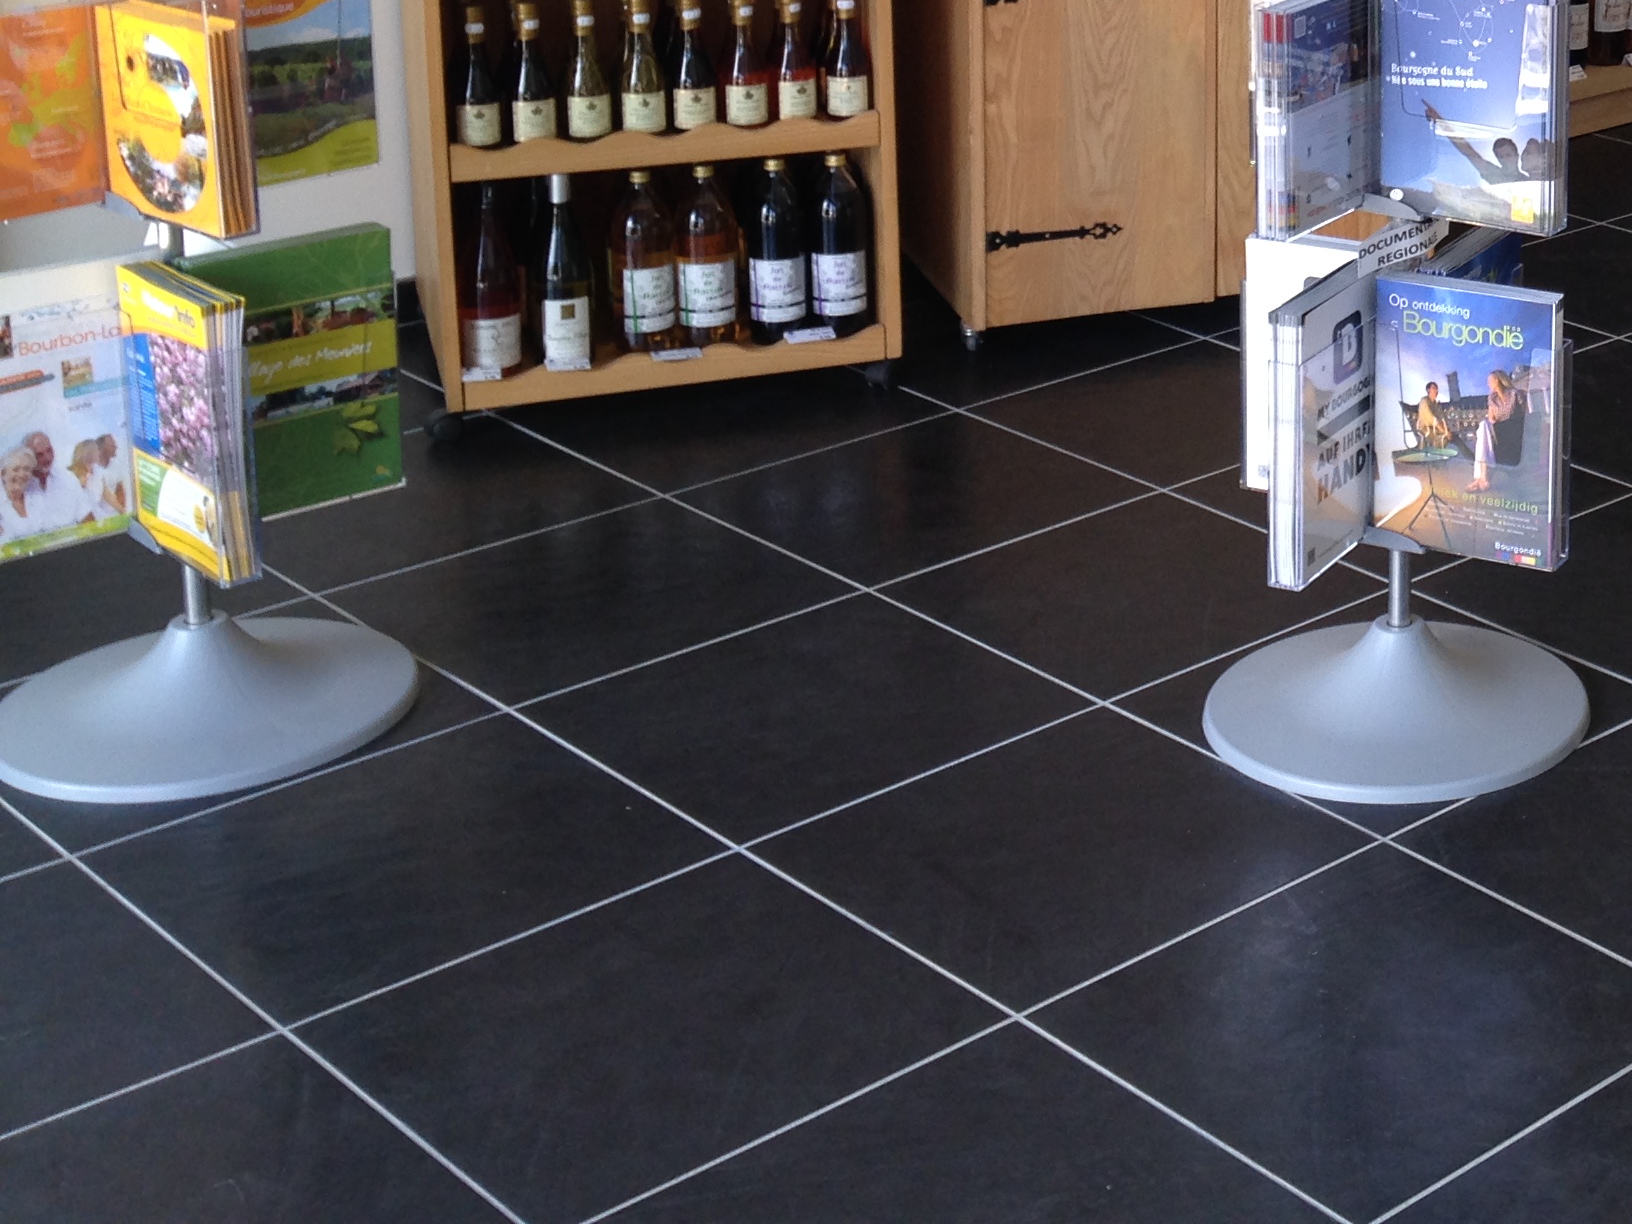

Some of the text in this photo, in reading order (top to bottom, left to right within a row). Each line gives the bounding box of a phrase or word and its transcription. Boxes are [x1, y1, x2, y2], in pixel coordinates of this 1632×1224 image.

[244, 1, 295, 18] ouristique
[1390, 62, 1474, 77] Bourgogne du Sud
[1408, 77, 1425, 86] sous
[1426, 78, 1440, 87] une
[1388, 293, 1471, 320] Op ontdekking
[18, 323, 122, 357] Bourbon-La
[1403, 310, 1524, 351] Bourgondië
[1461, 490, 1477, 502] en
[1480, 495, 1539, 516] veelzijdig
